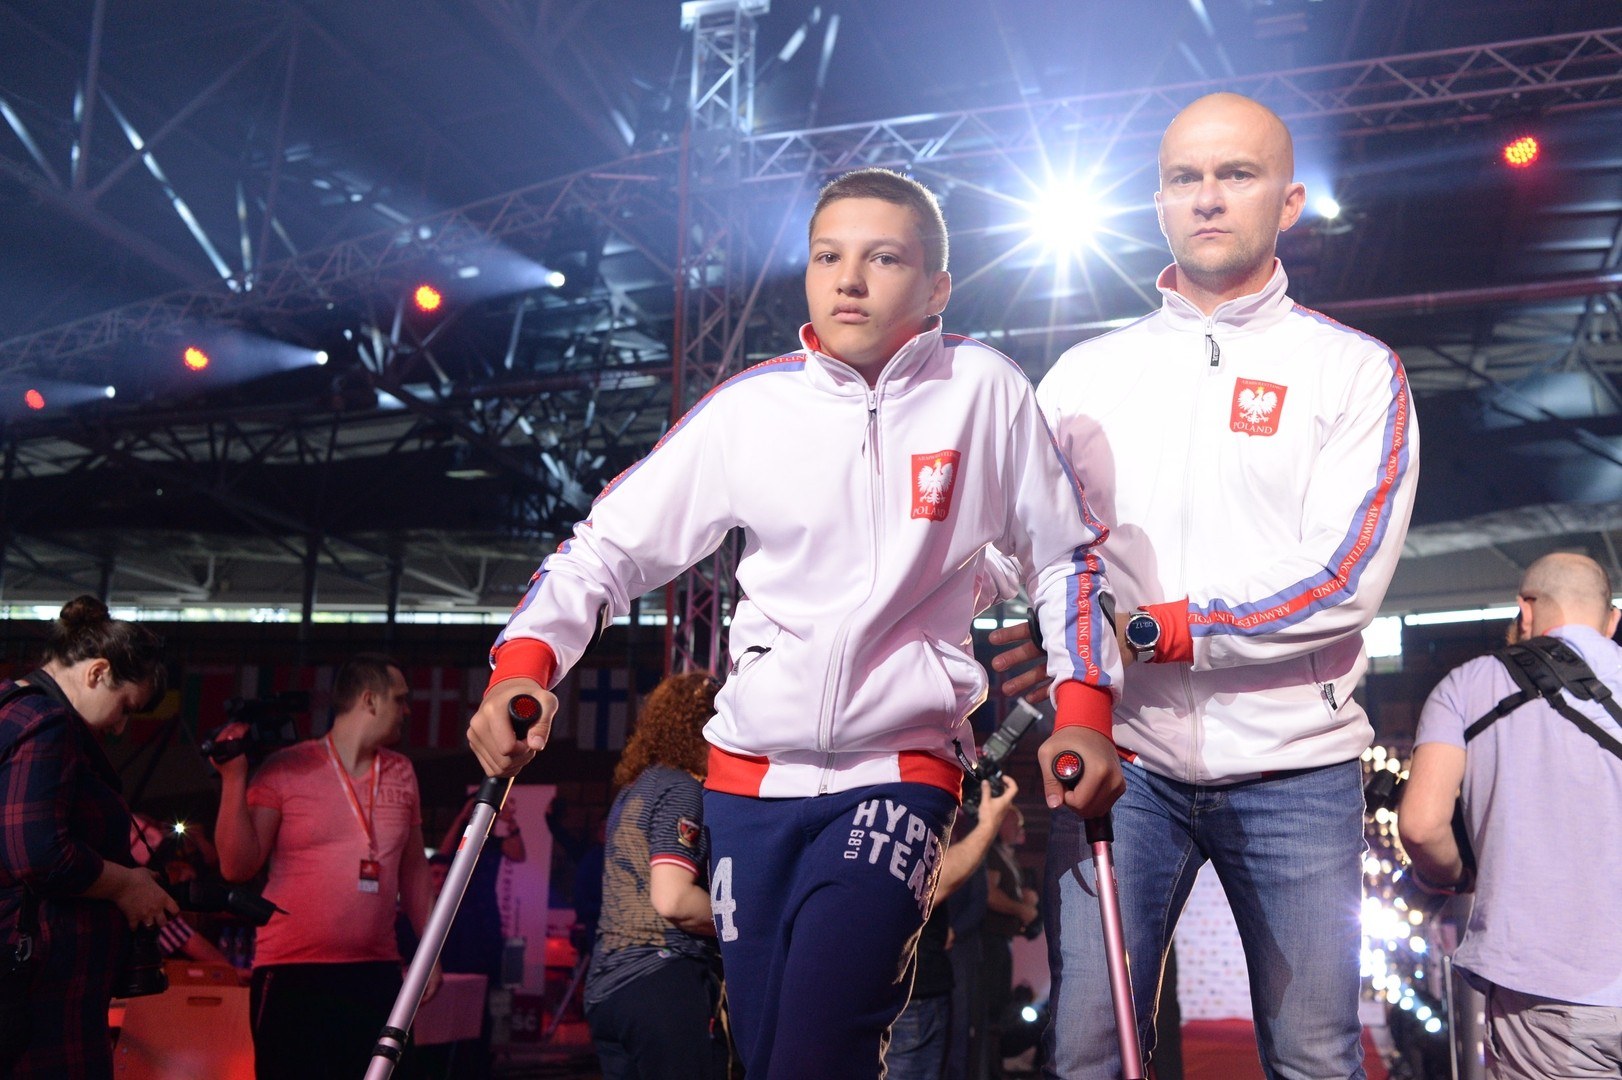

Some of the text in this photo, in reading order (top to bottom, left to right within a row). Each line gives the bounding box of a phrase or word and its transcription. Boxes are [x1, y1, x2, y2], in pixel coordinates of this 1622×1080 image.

[1233, 421, 1273, 434] POLAND
[912, 505, 946, 518] POLAND
[1313, 573, 1348, 599] PLAND
[844, 829, 865, 859] 0.89
[711, 857, 739, 942] 4
